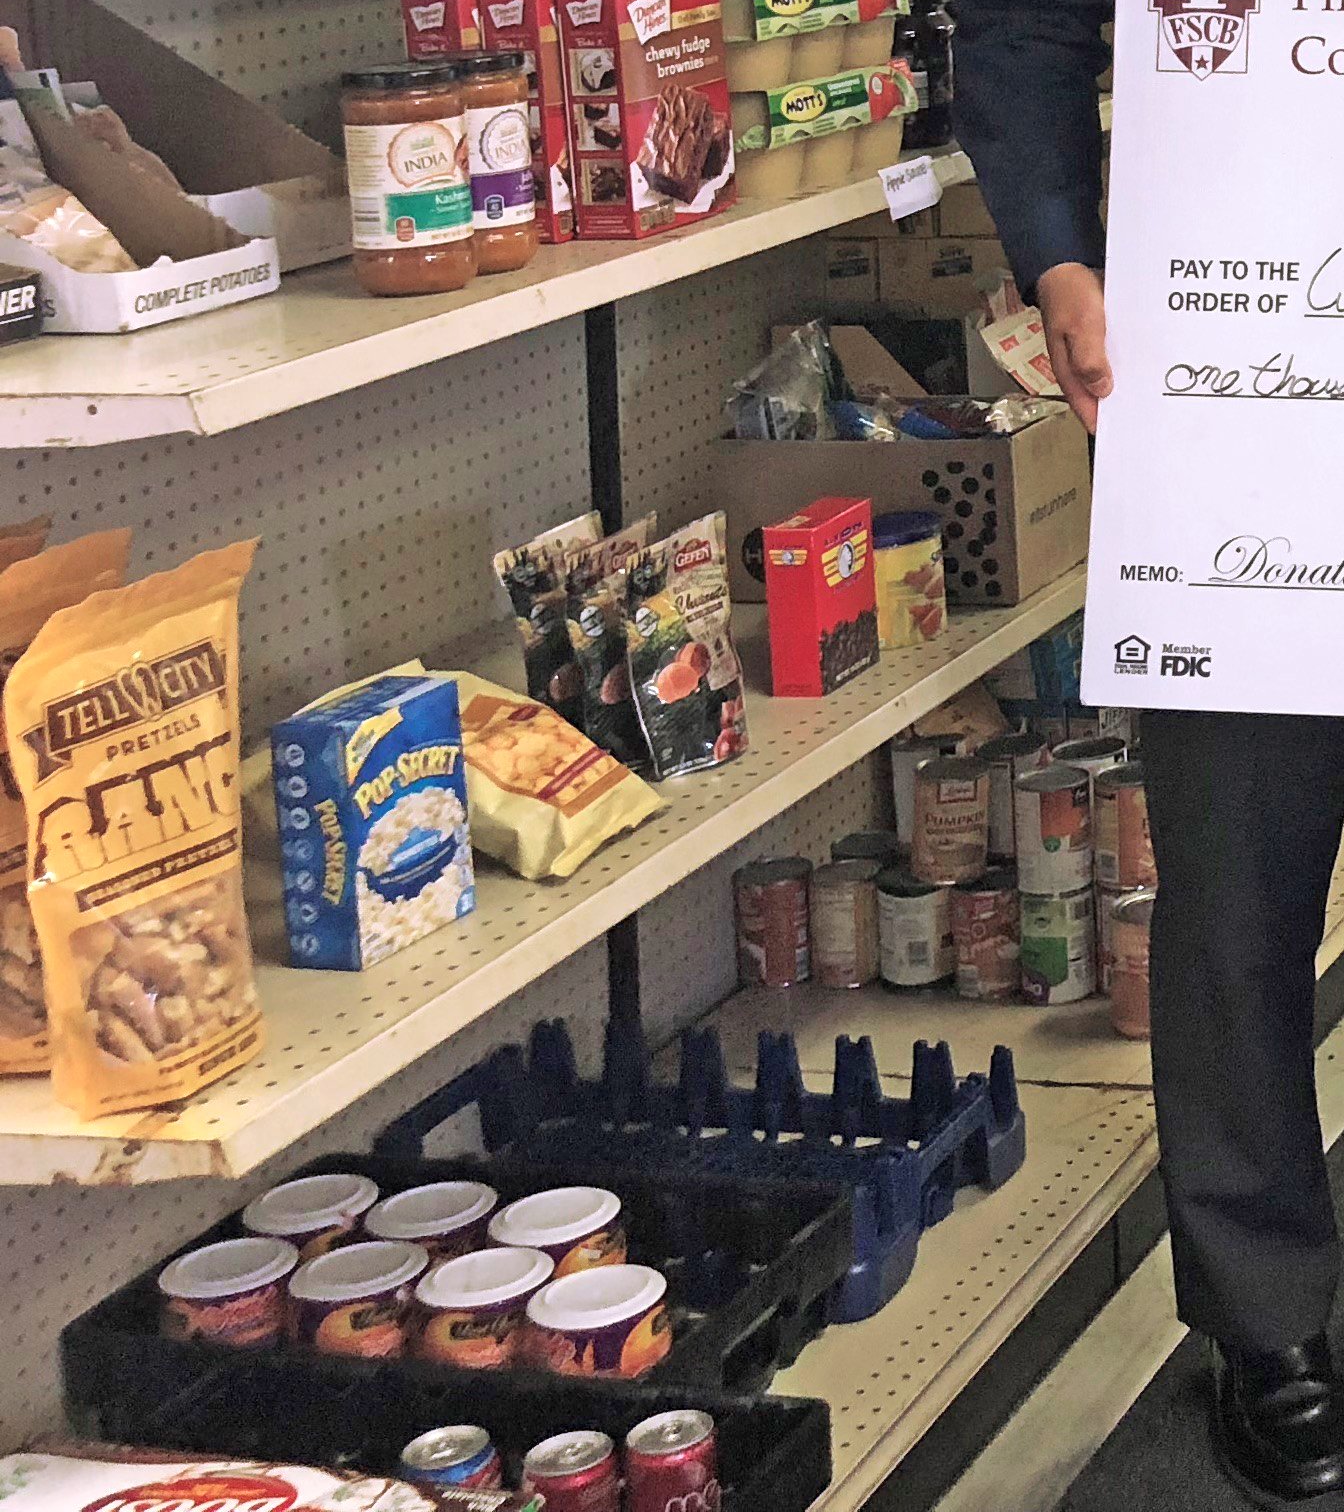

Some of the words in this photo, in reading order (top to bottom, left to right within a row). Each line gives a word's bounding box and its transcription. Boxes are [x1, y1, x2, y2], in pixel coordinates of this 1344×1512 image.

[1166, 13, 1240, 46] FSCB
[645, 40, 682, 64] chewy
[681, 35, 711, 58] fudge
[657, 56, 705, 80] brownies
[784, 89, 825, 116] MOTT'S
[403, 151, 449, 174] INDIA
[1169, 259, 1215, 280] PAY
[1219, 260, 1249, 281] TO
[1255, 261, 1301, 282] THE
[134, 279, 208, 315] COMPLETE
[209, 261, 272, 296] POTATOES
[1167, 292, 1250, 314] ORDER
[1257, 294, 1289, 314] OF
[1164, 361, 1245, 395] one
[675, 546, 712, 568] GEFEN
[1119, 564, 1184, 583] MEMO:
[1161, 643, 1213, 656] Member
[1159, 655, 1213, 678] FDIC
[57, 687, 131, 740] TELL
[159, 650, 217, 700] CITY
[105, 711, 202, 763] PRETZELS
